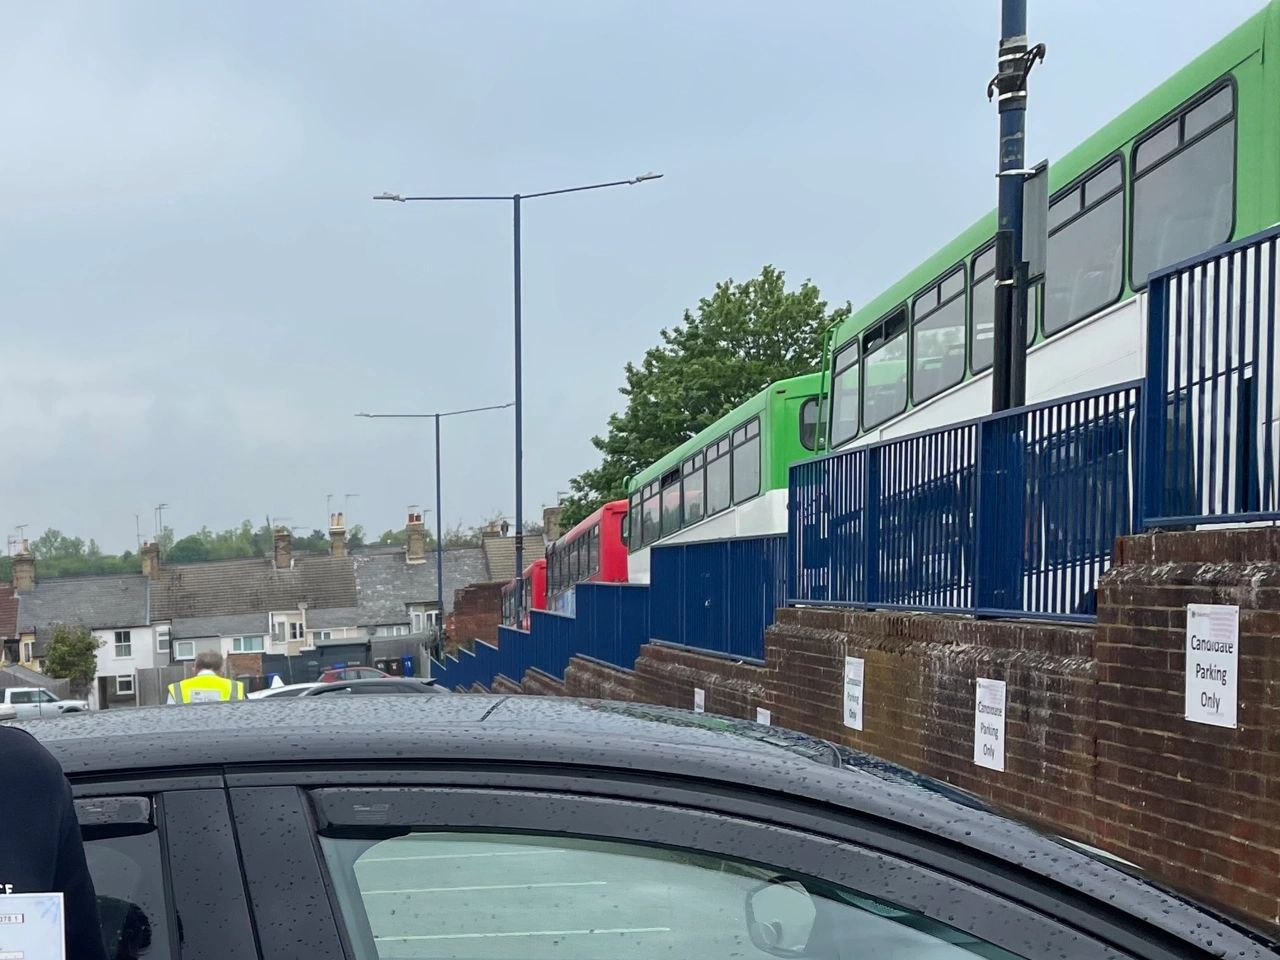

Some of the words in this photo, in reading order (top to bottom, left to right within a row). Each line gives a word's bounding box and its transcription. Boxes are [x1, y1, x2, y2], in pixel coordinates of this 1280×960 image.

[1195, 663, 1228, 686] Parking
[1200, 691, 1222, 714] Only
[980, 721, 999, 740] Parking
[982, 743, 995, 761] Only
